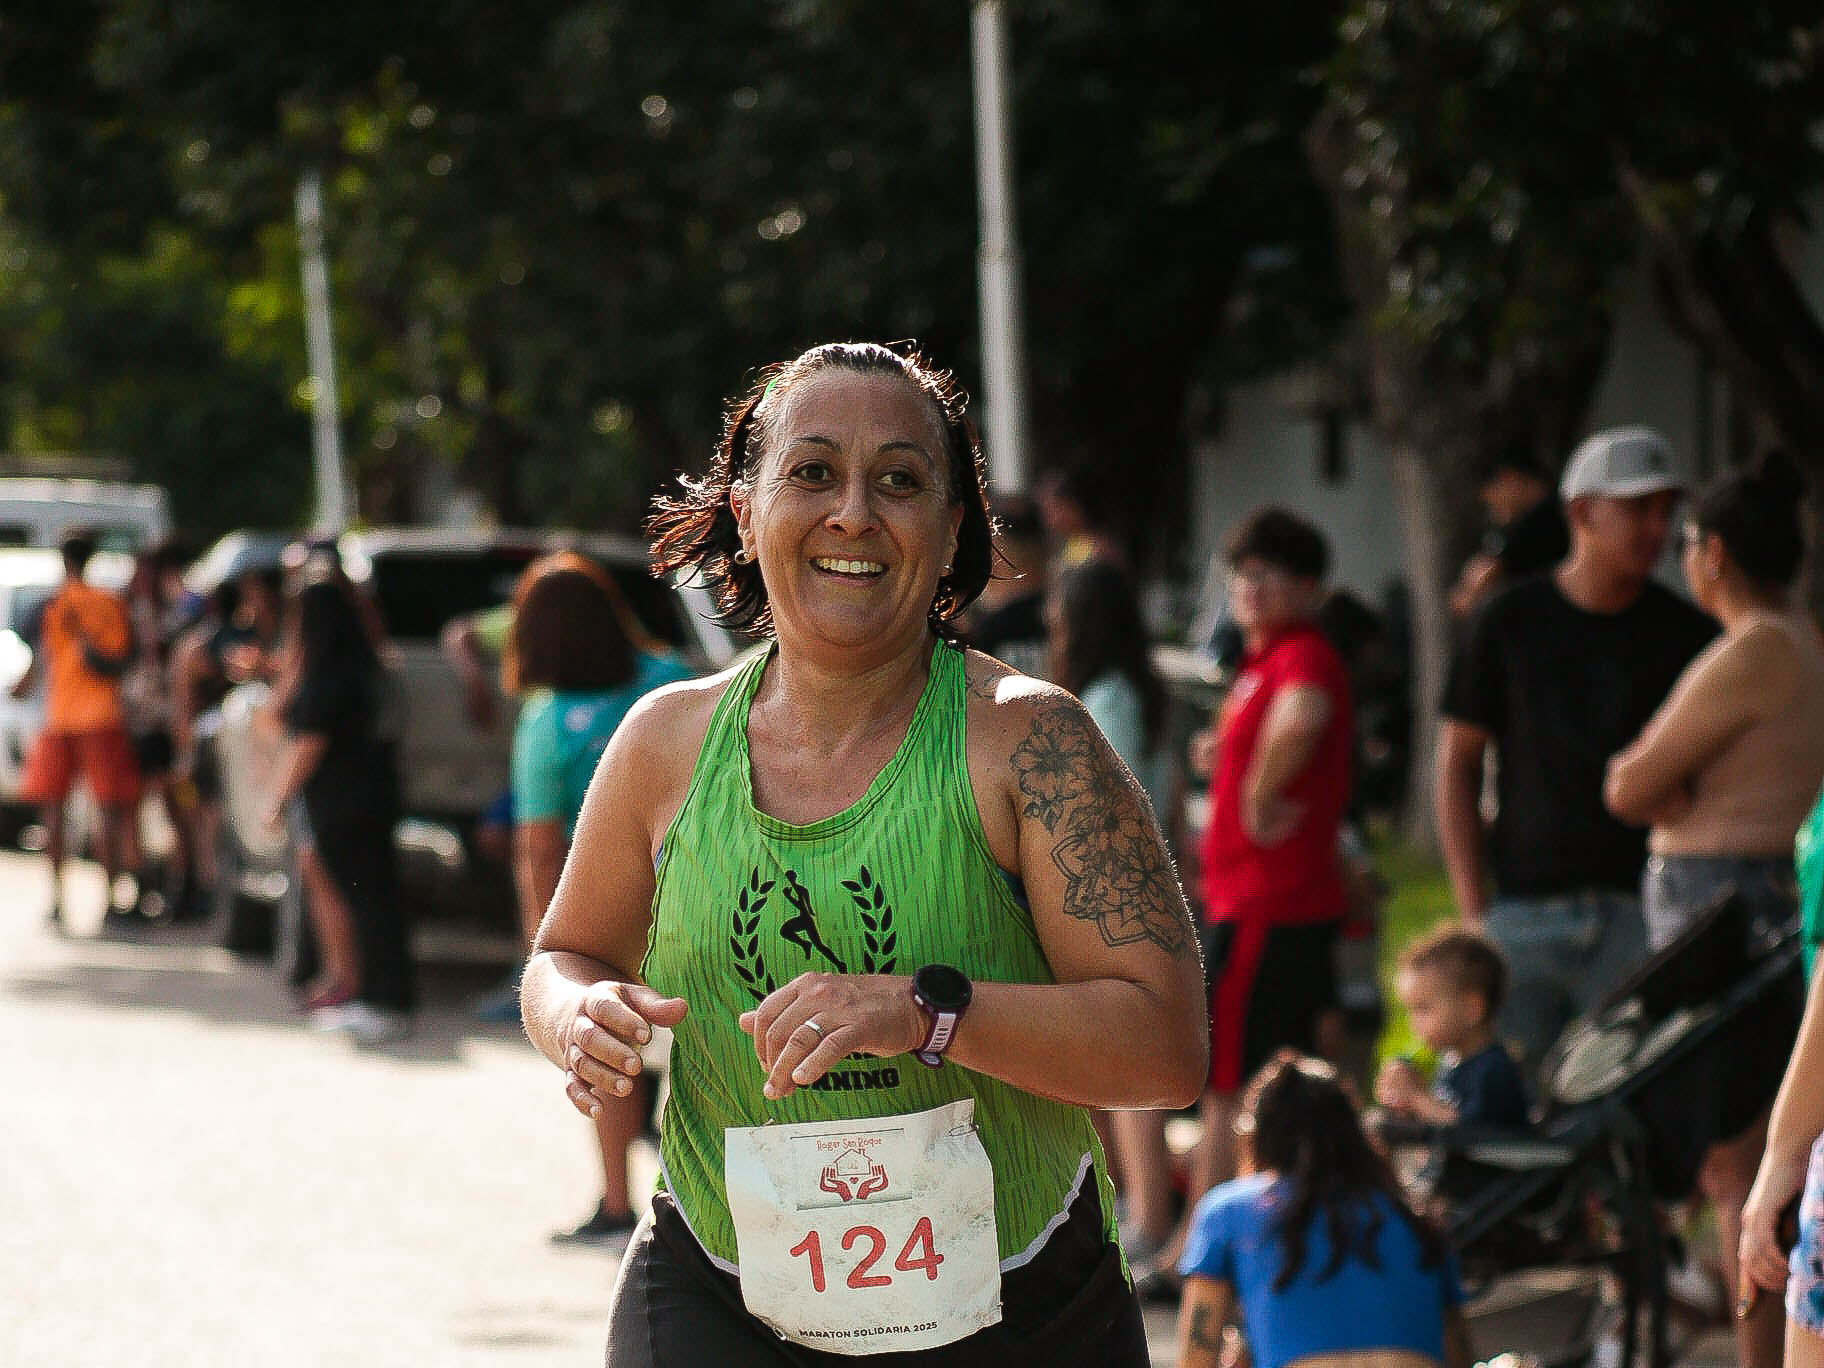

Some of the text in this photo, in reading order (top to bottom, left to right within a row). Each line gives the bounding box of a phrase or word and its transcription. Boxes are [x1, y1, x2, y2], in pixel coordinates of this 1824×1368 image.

[790, 1216, 945, 1293] 124
[799, 1321, 938, 1338] MARATON SOLIDARIA 2025
